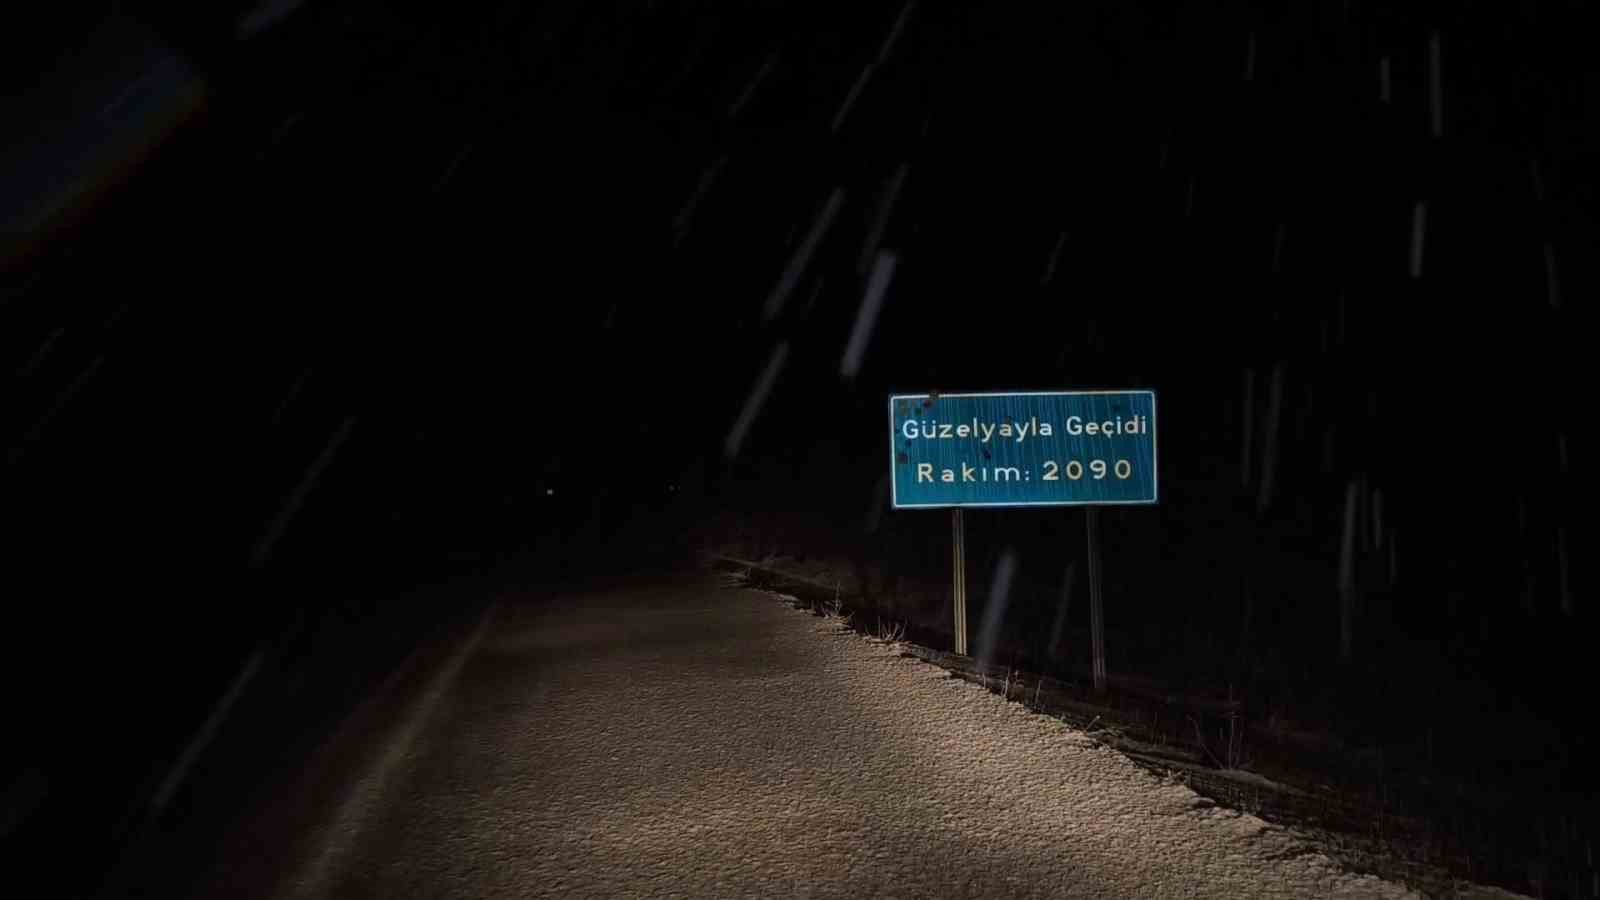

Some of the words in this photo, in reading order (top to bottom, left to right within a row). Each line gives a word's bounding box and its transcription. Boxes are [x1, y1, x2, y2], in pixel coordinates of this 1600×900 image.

[902, 417, 1053, 442] Güzelyayla
[1066, 415, 1147, 438] Geçidi
[918, 462, 1030, 482] Rakım:
[1042, 459, 1132, 480] 2090
